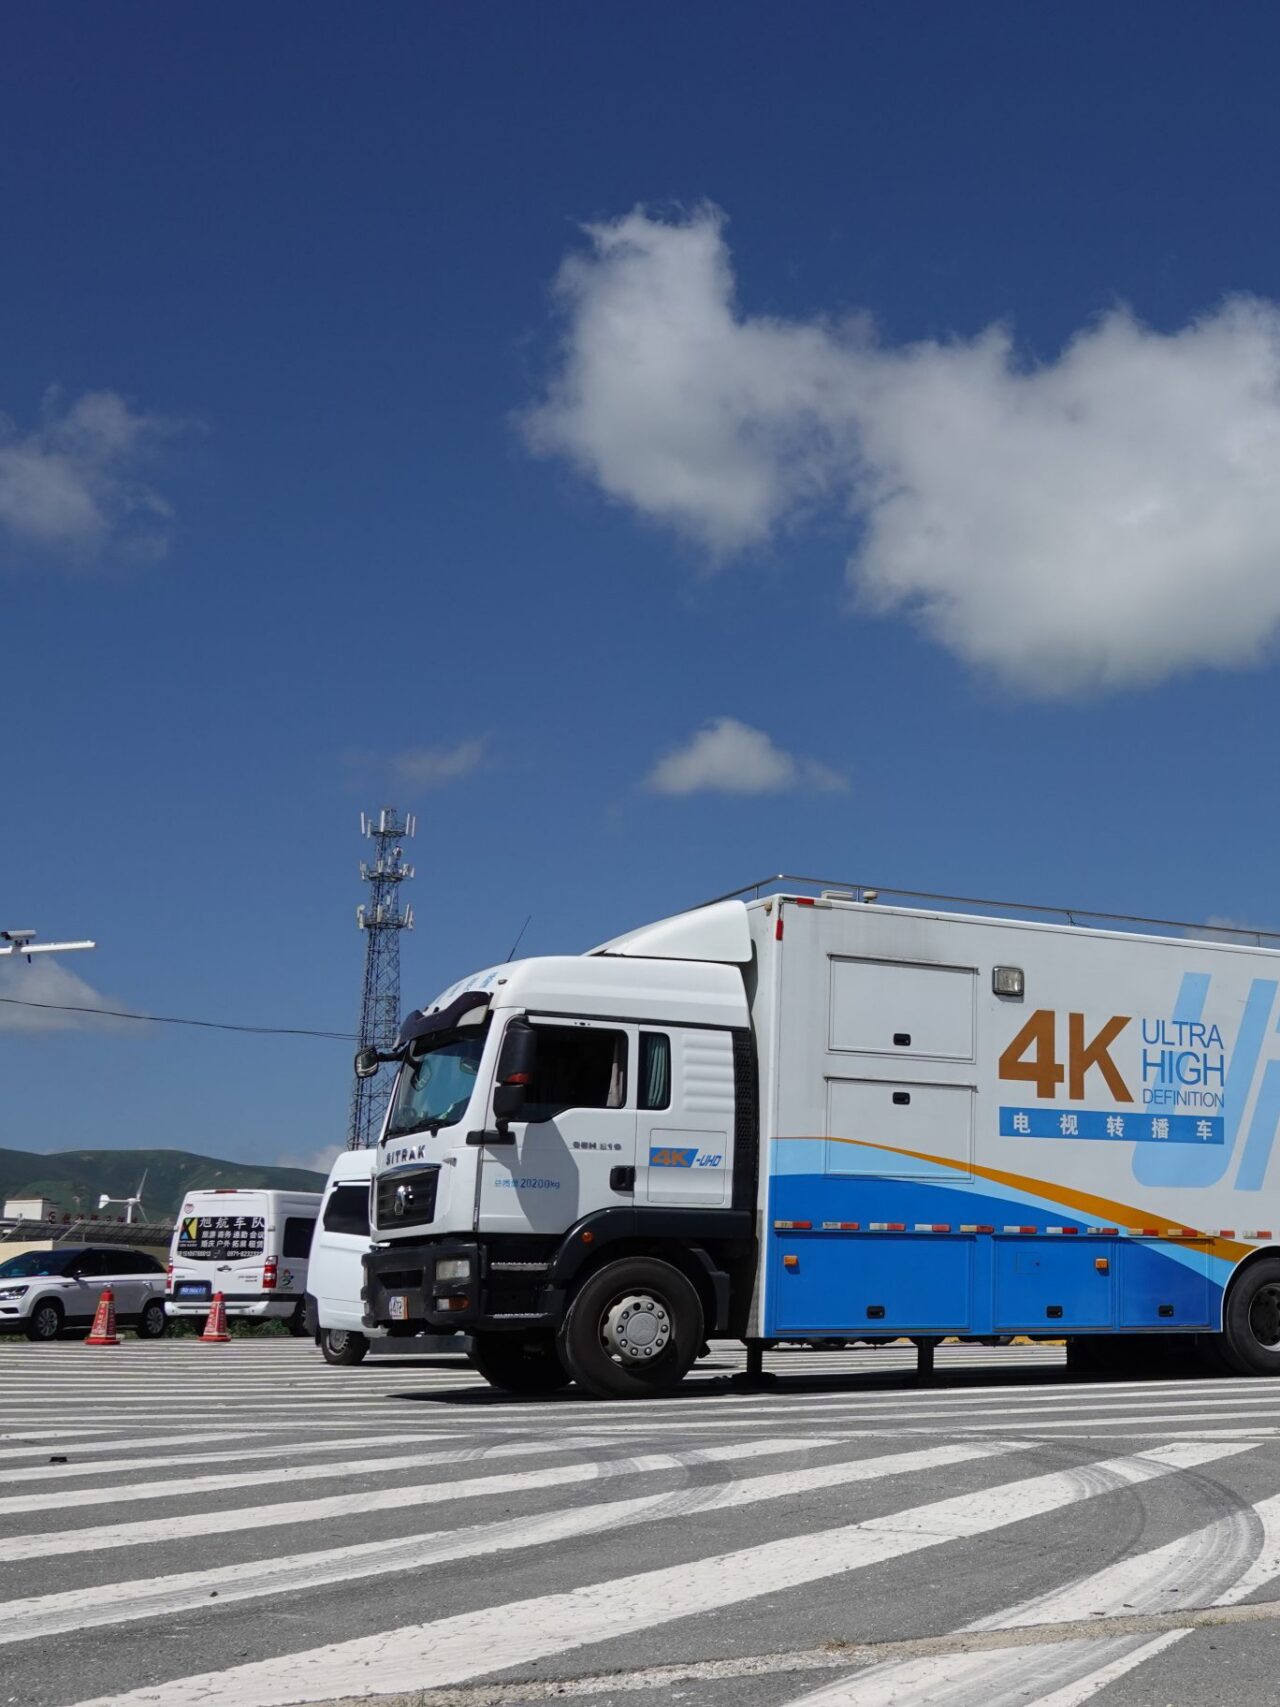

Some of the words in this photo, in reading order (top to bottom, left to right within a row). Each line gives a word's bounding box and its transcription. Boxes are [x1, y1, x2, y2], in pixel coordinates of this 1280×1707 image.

[1142, 1018, 1225, 1050] ULTRA
[999, 1009, 1135, 1103] 4K
[1142, 1050, 1225, 1087] HIGH
[1142, 1088, 1225, 1109] DEFINITION
[1012, 1112, 1213, 1141] 电视转播车
[386, 1144, 426, 1166] SITRAK
[651, 1149, 690, 1167] 4K
[695, 1153, 723, 1167] -UHD
[198, 1216, 265, 1230] 旭航车队
